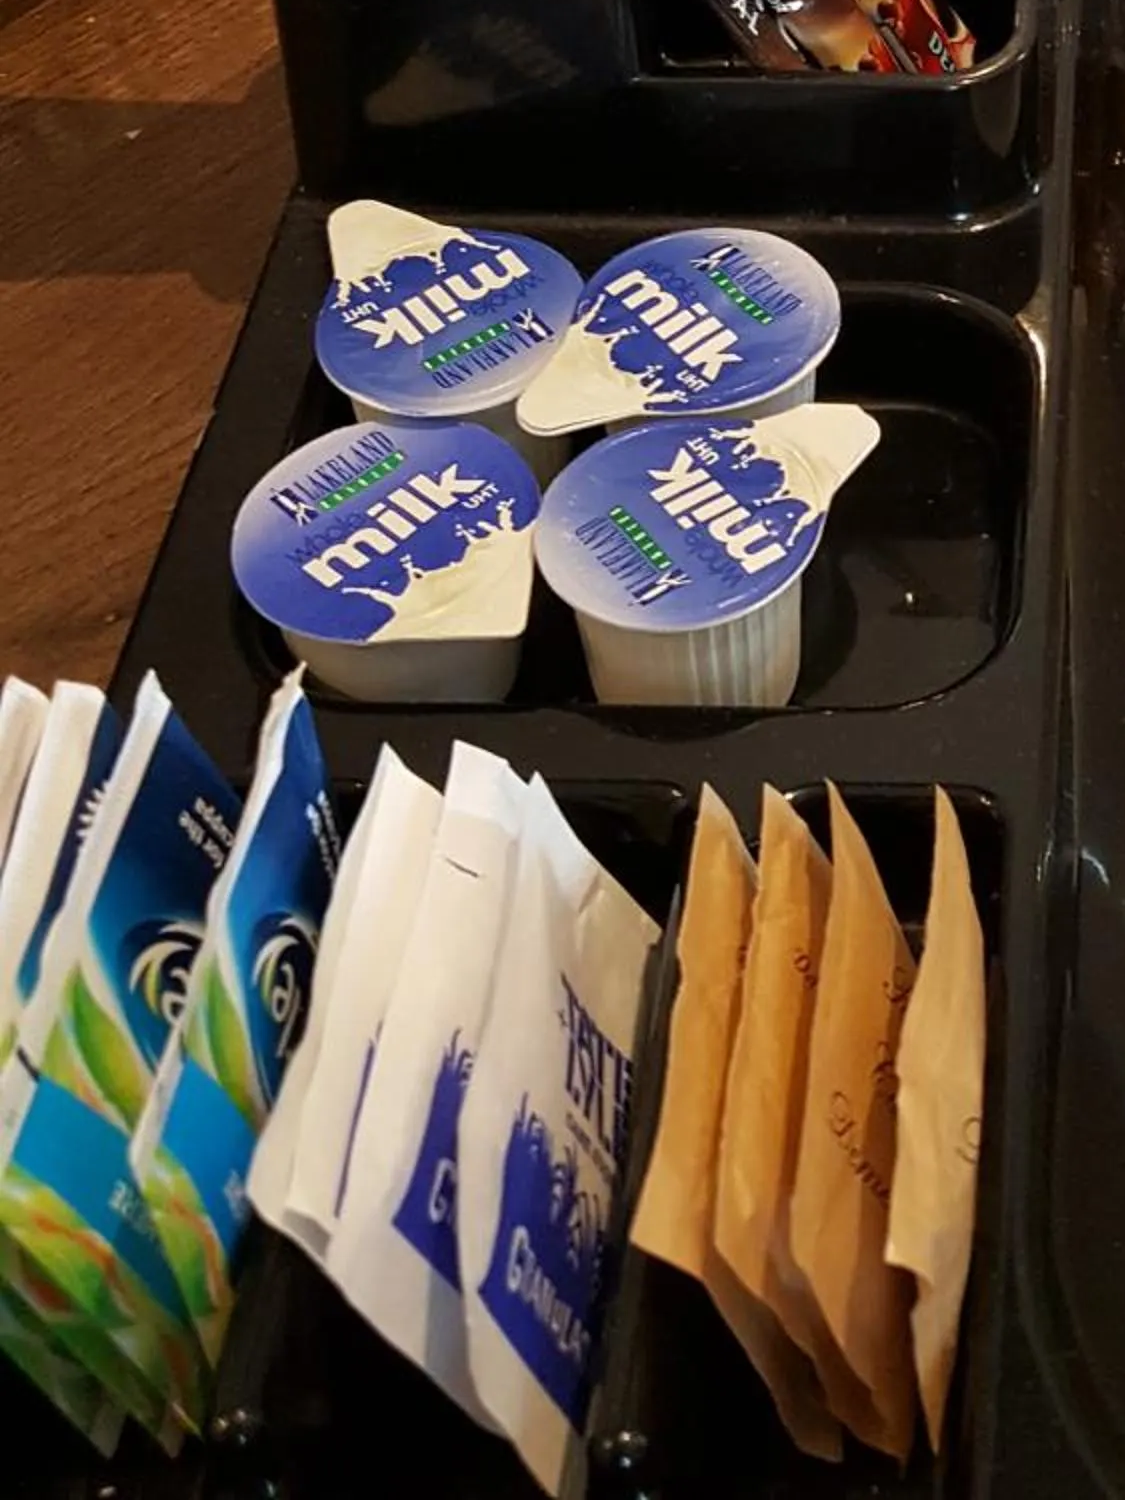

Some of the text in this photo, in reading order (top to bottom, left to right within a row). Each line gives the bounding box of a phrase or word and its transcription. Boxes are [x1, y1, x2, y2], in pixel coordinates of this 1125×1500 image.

[341, 301, 380, 323] UHT
[352, 248, 531, 349] milk
[604, 269, 744, 381] milk
[675, 369, 710, 393] UHT
[431, 331, 533, 389] LAKELAND
[293, 430, 396, 498] LAKELAND
[647, 436, 788, 574] milk UHT
[302, 463, 488, 588] milk
[461, 483, 500, 510] UHT
